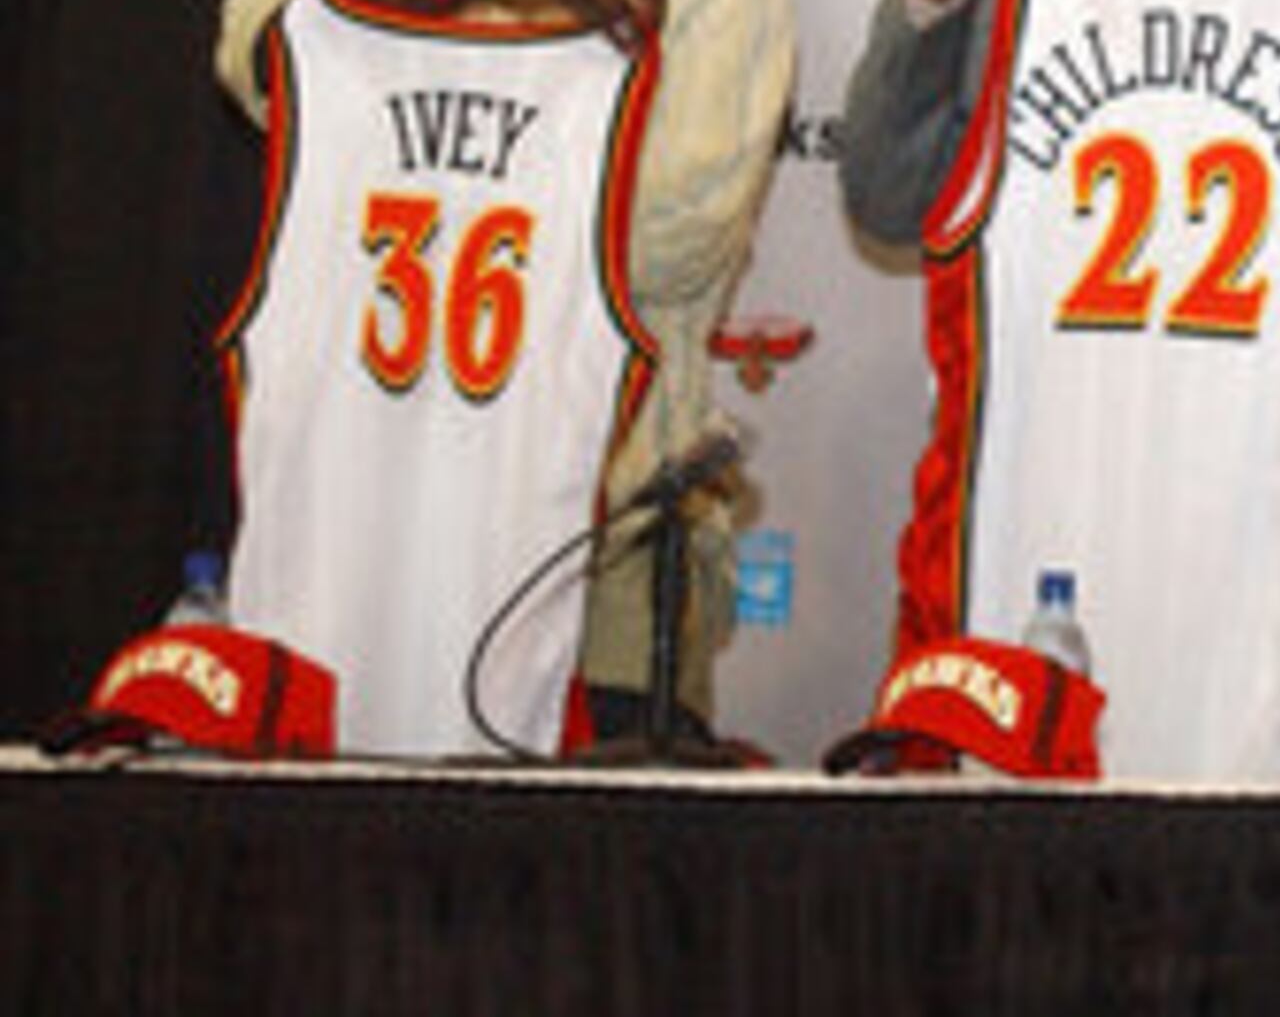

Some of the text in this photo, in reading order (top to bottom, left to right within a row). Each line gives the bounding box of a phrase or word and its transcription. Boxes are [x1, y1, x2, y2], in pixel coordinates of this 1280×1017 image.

[388, 90, 541, 181] IVEY
[1053, 129, 1273, 339] 22
[361, 191, 537, 403] 36
